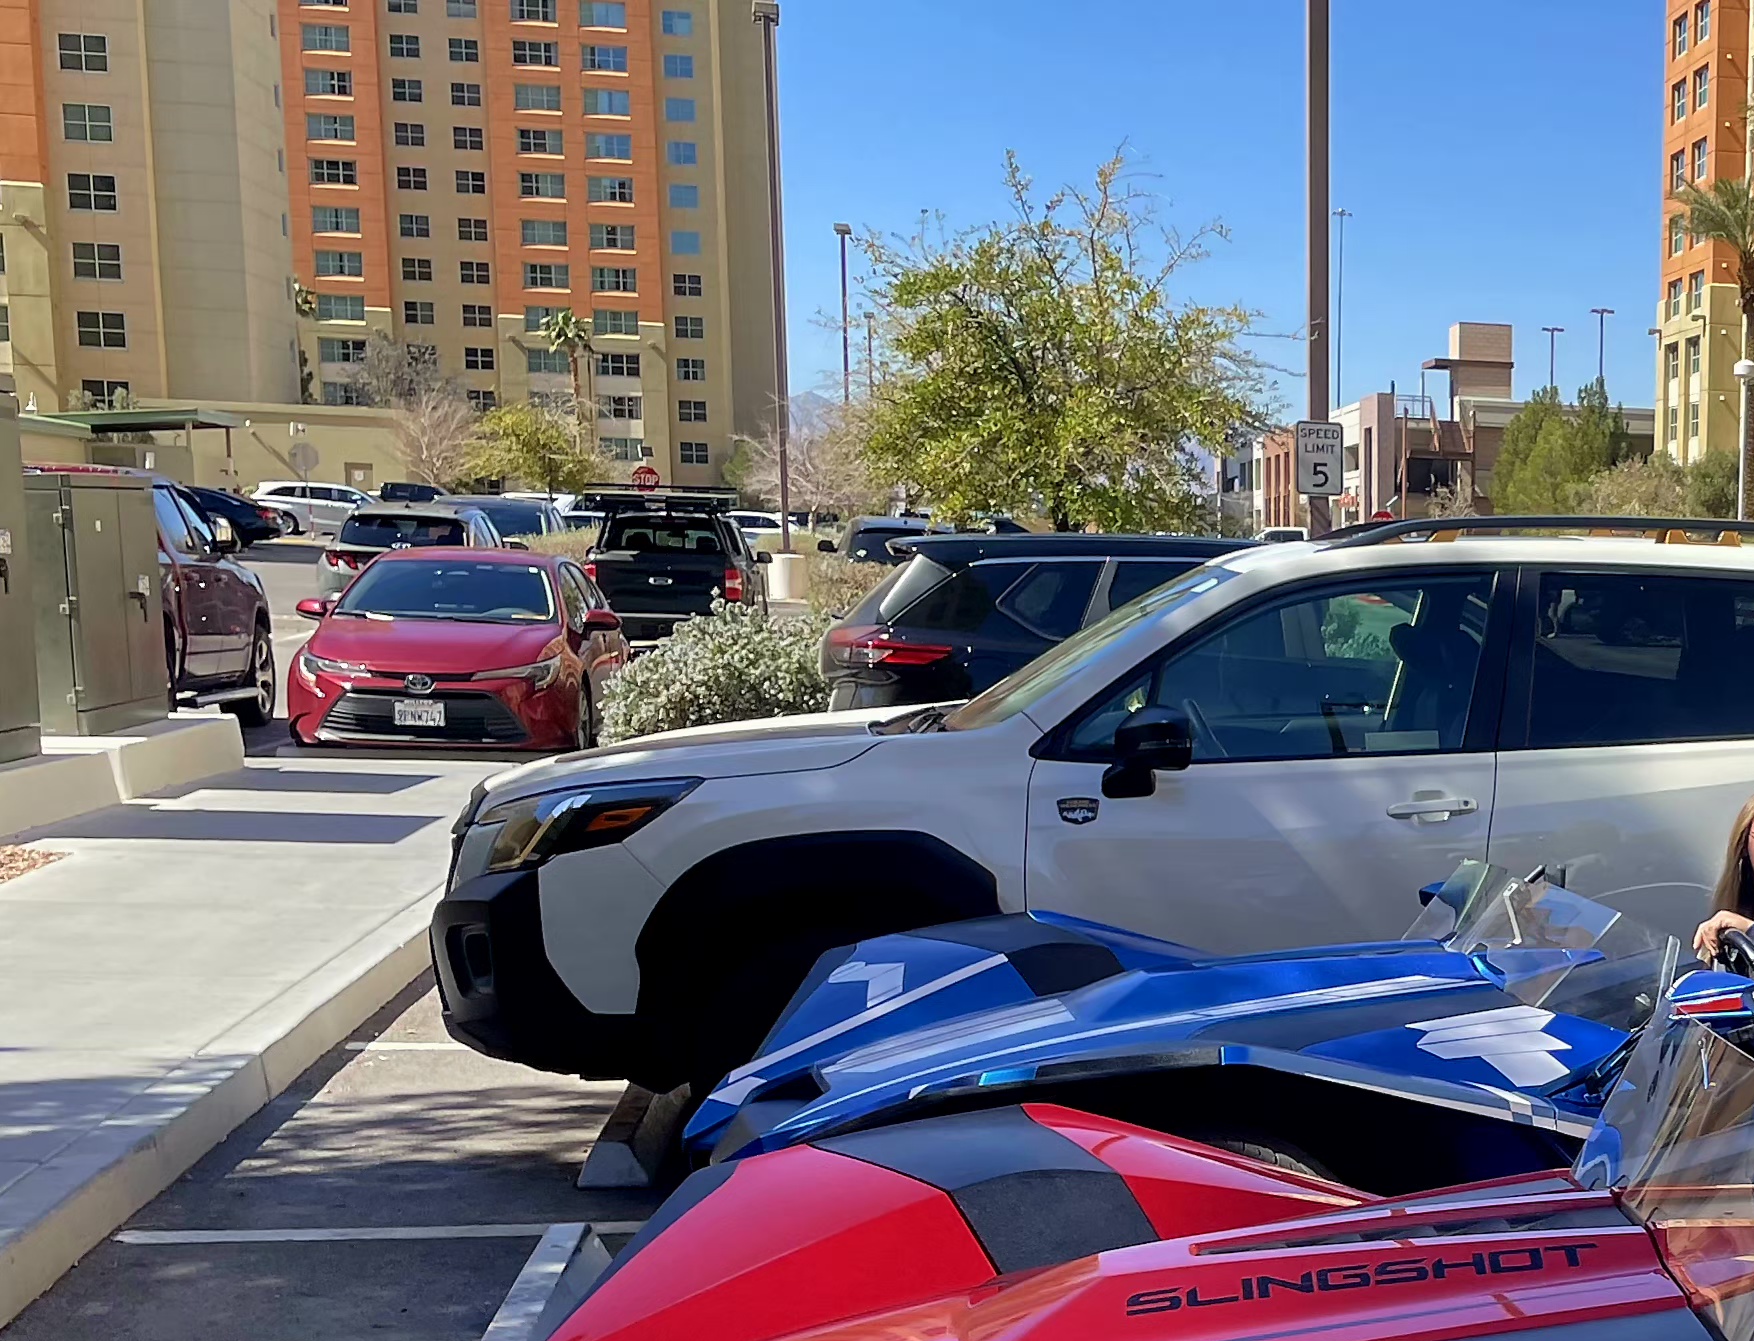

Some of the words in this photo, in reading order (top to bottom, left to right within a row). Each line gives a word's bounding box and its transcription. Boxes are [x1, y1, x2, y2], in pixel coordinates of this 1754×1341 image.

[1300, 428, 1340, 440] SPEED
[1305, 443, 1336, 454] LIMIT
[633, 473, 659, 485] STOP
[1312, 462, 1329, 488] 5
[1126, 1243, 1597, 1316] SLINGSHOT
